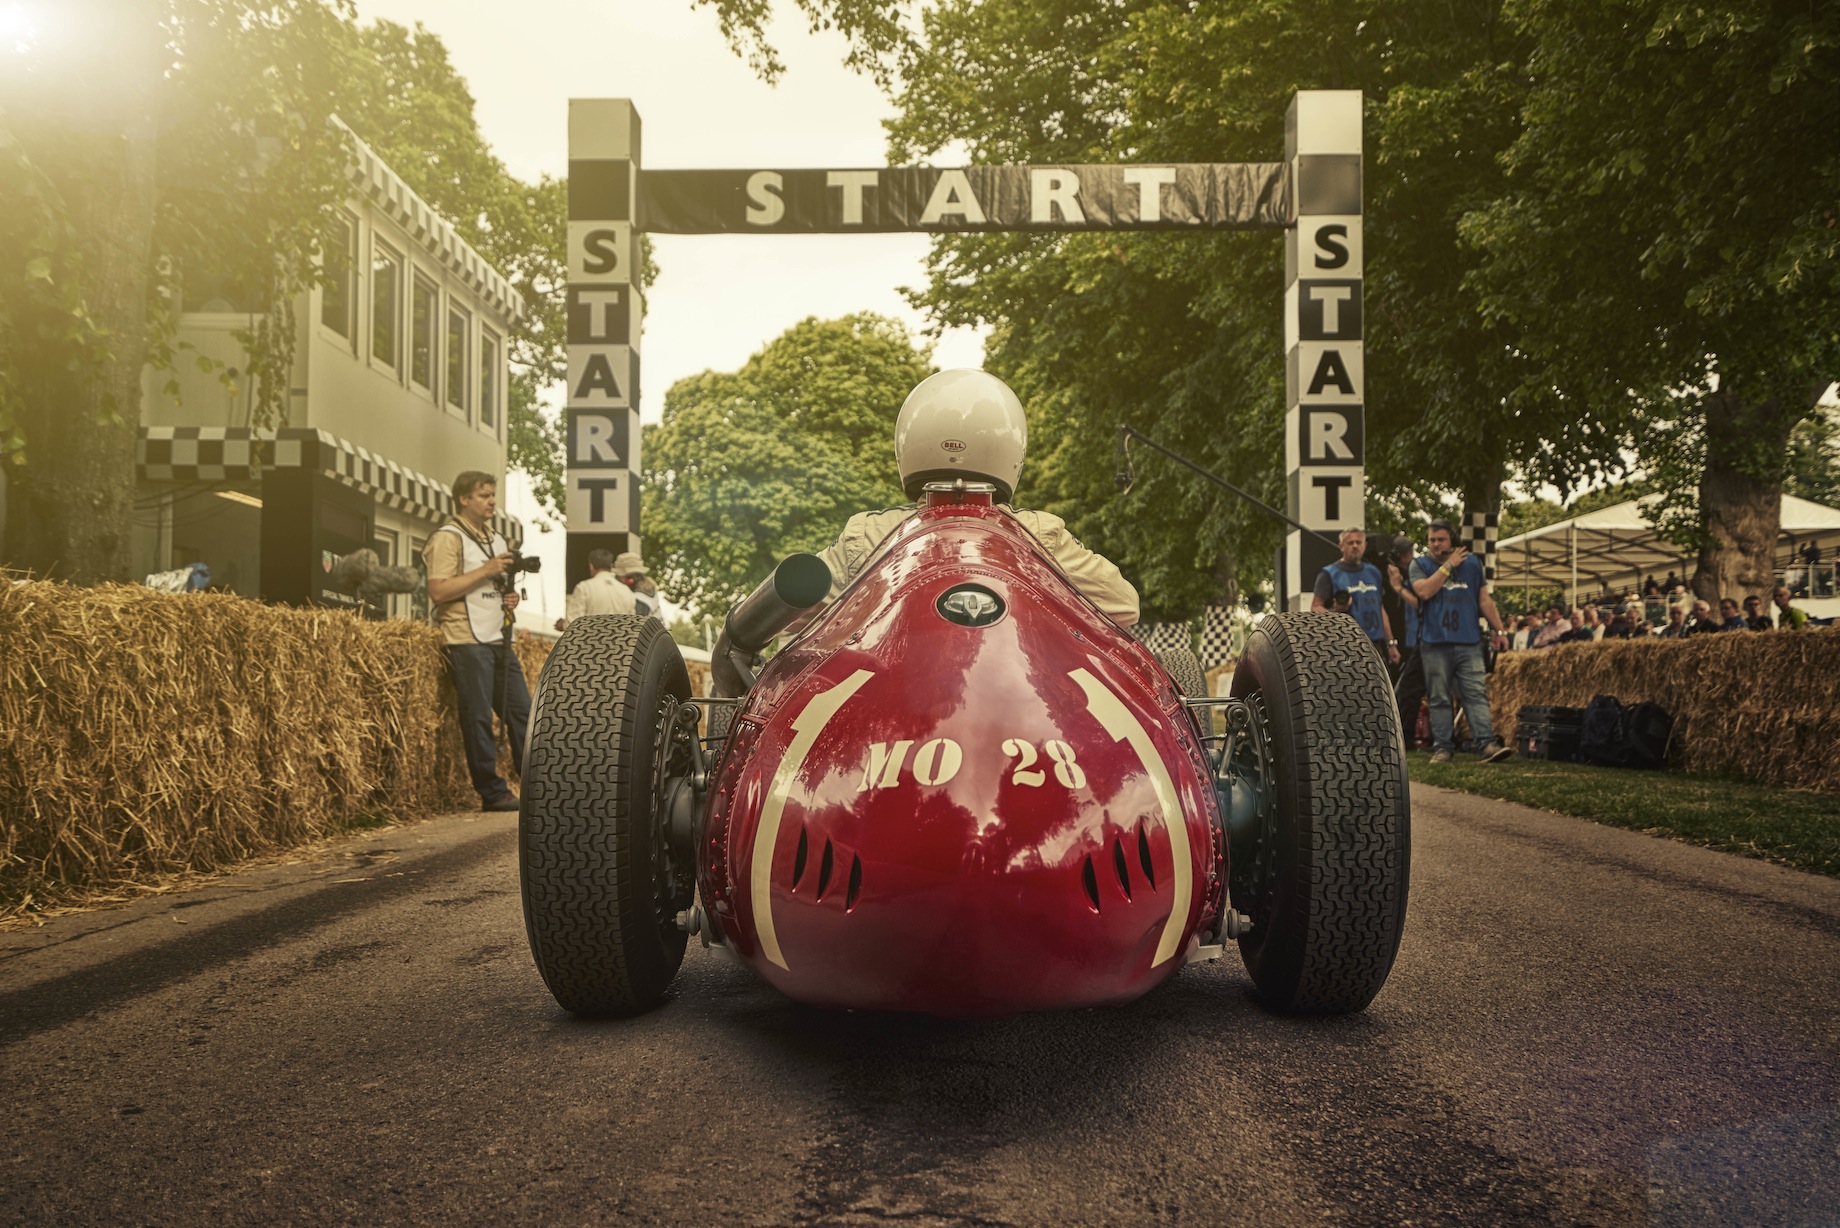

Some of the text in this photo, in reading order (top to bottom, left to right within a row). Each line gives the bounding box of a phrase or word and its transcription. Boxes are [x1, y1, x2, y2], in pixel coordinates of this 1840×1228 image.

[745, 167, 1177, 226] START
[573, 229, 622, 523] START
[1306, 224, 1356, 521] START
[1442, 609, 1460, 632] 48
[856, 738, 1087, 792] MO 28
